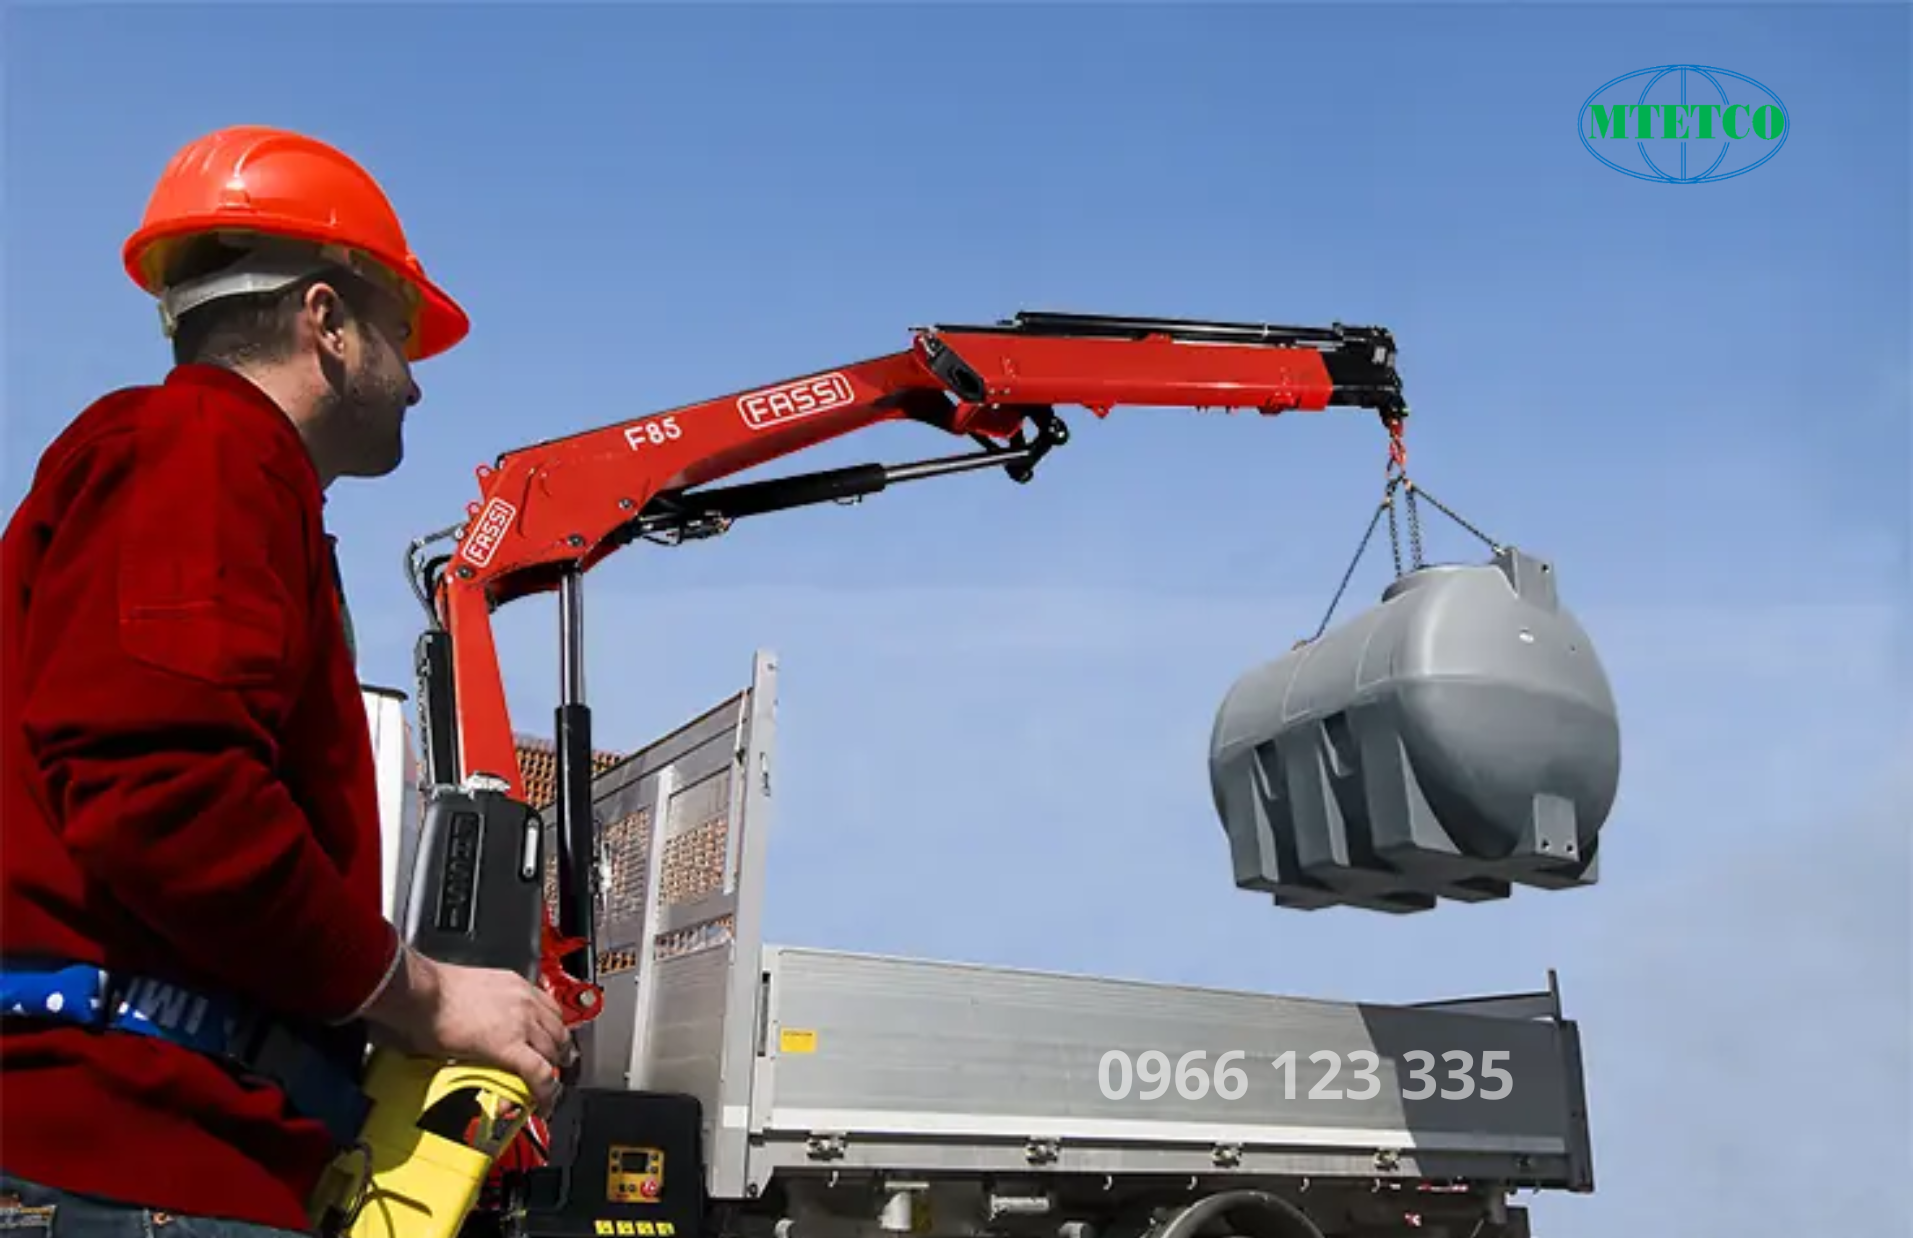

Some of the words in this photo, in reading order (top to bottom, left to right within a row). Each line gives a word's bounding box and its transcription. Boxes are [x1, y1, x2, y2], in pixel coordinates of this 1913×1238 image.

[746, 378, 847, 423] FASSI
[624, 416, 682, 451] F85
[466, 502, 511, 562] FASSI
